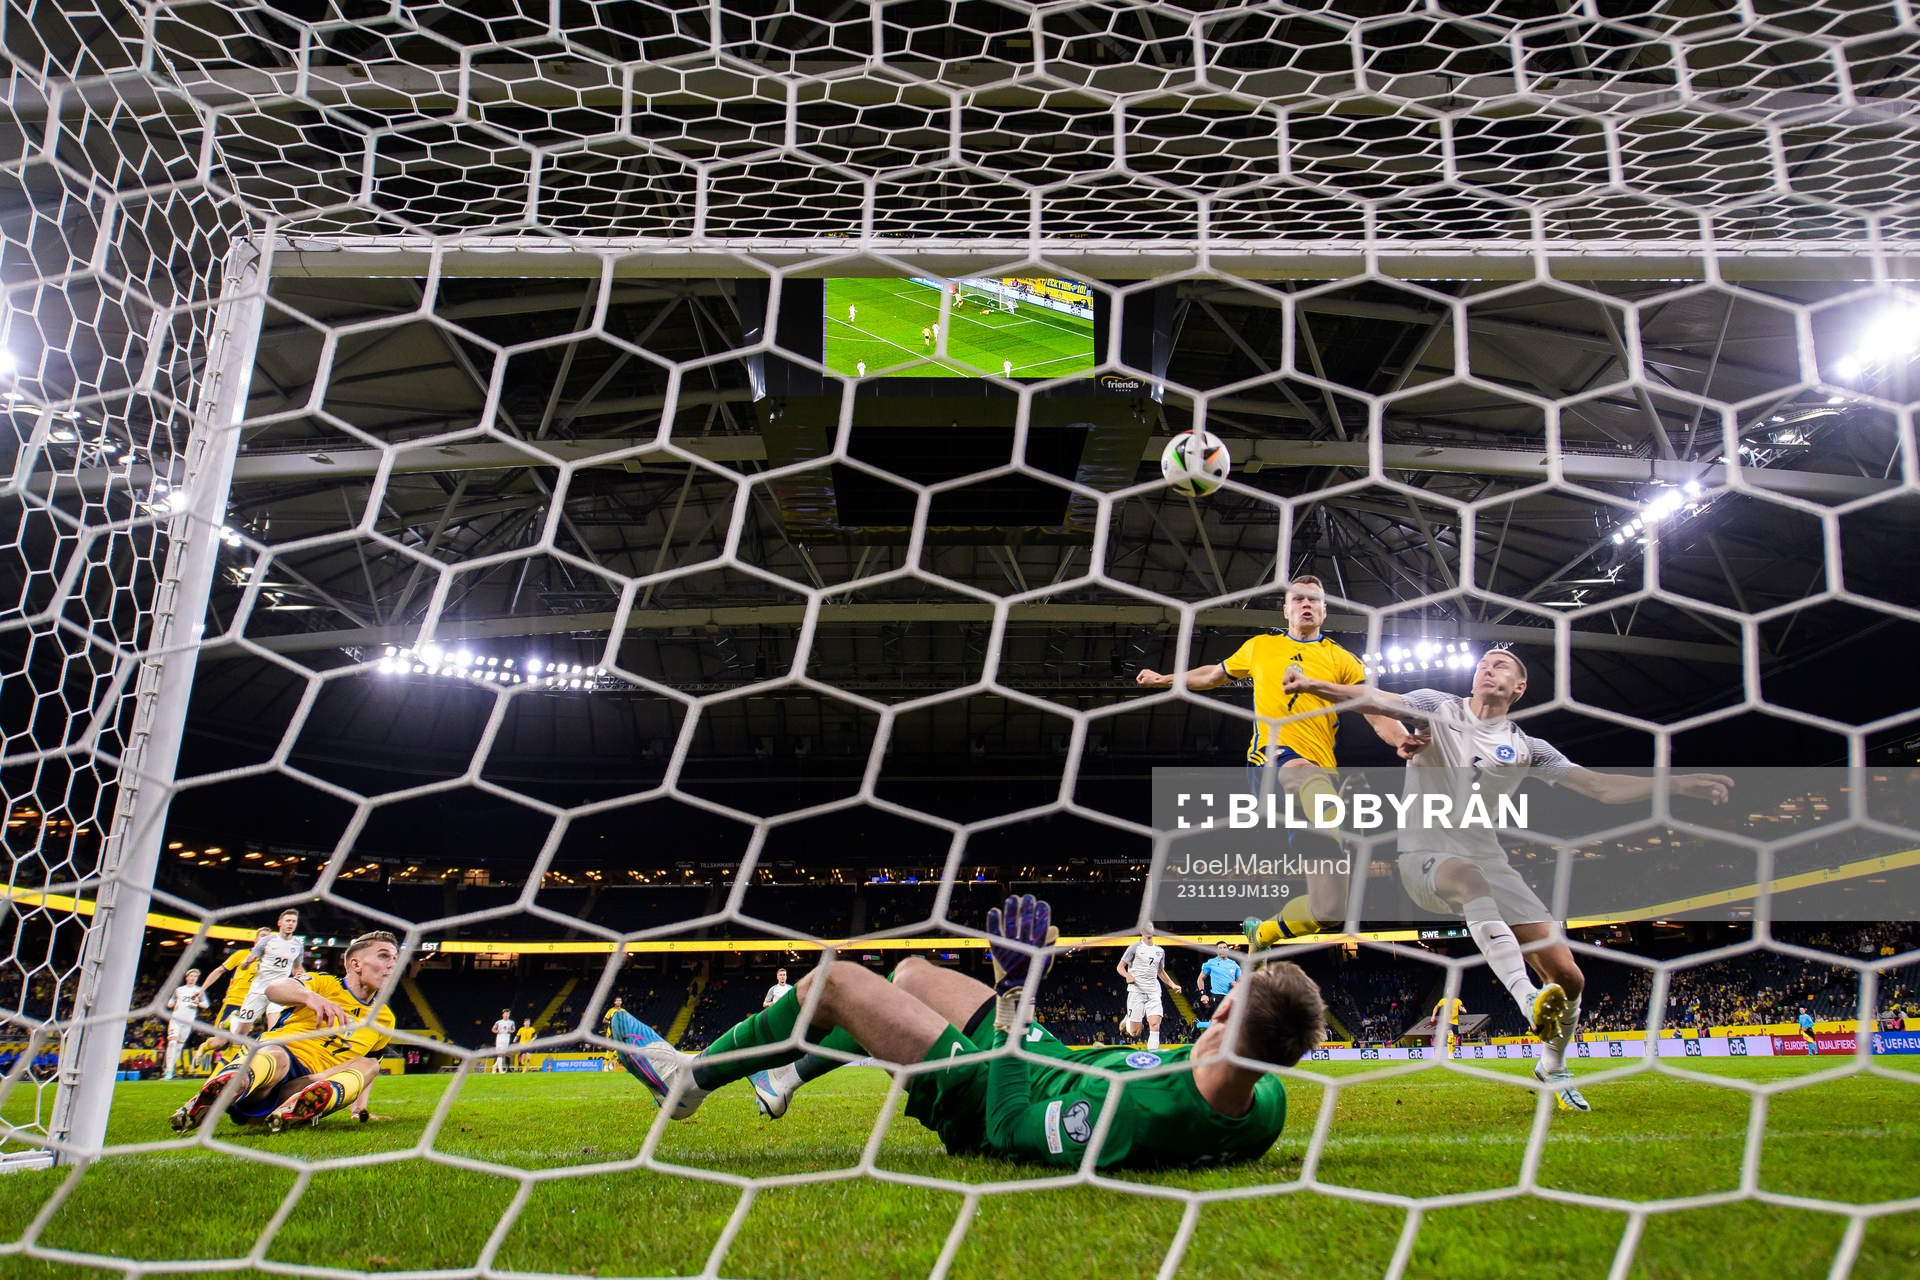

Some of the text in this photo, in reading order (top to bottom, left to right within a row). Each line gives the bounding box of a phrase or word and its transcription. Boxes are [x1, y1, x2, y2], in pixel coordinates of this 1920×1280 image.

[1107, 379, 1139, 389] friends
[1421, 928, 1468, 939] SWE 0
[421, 942, 440, 951] EST
[273, 957, 289, 968] 20
[1148, 957, 1155, 966] 7
[239, 1008, 254, 1020] 20
[1685, 1040, 1701, 1056] CTC
[1729, 1039, 1746, 1055] CTC
[1784, 1039, 1857, 1051] EUROPE QUALIFIERS
[1884, 1037, 1909, 1049] UEFA
[1311, 1050, 1329, 1060] CTC
[1361, 1049, 1378, 1059] CTC
